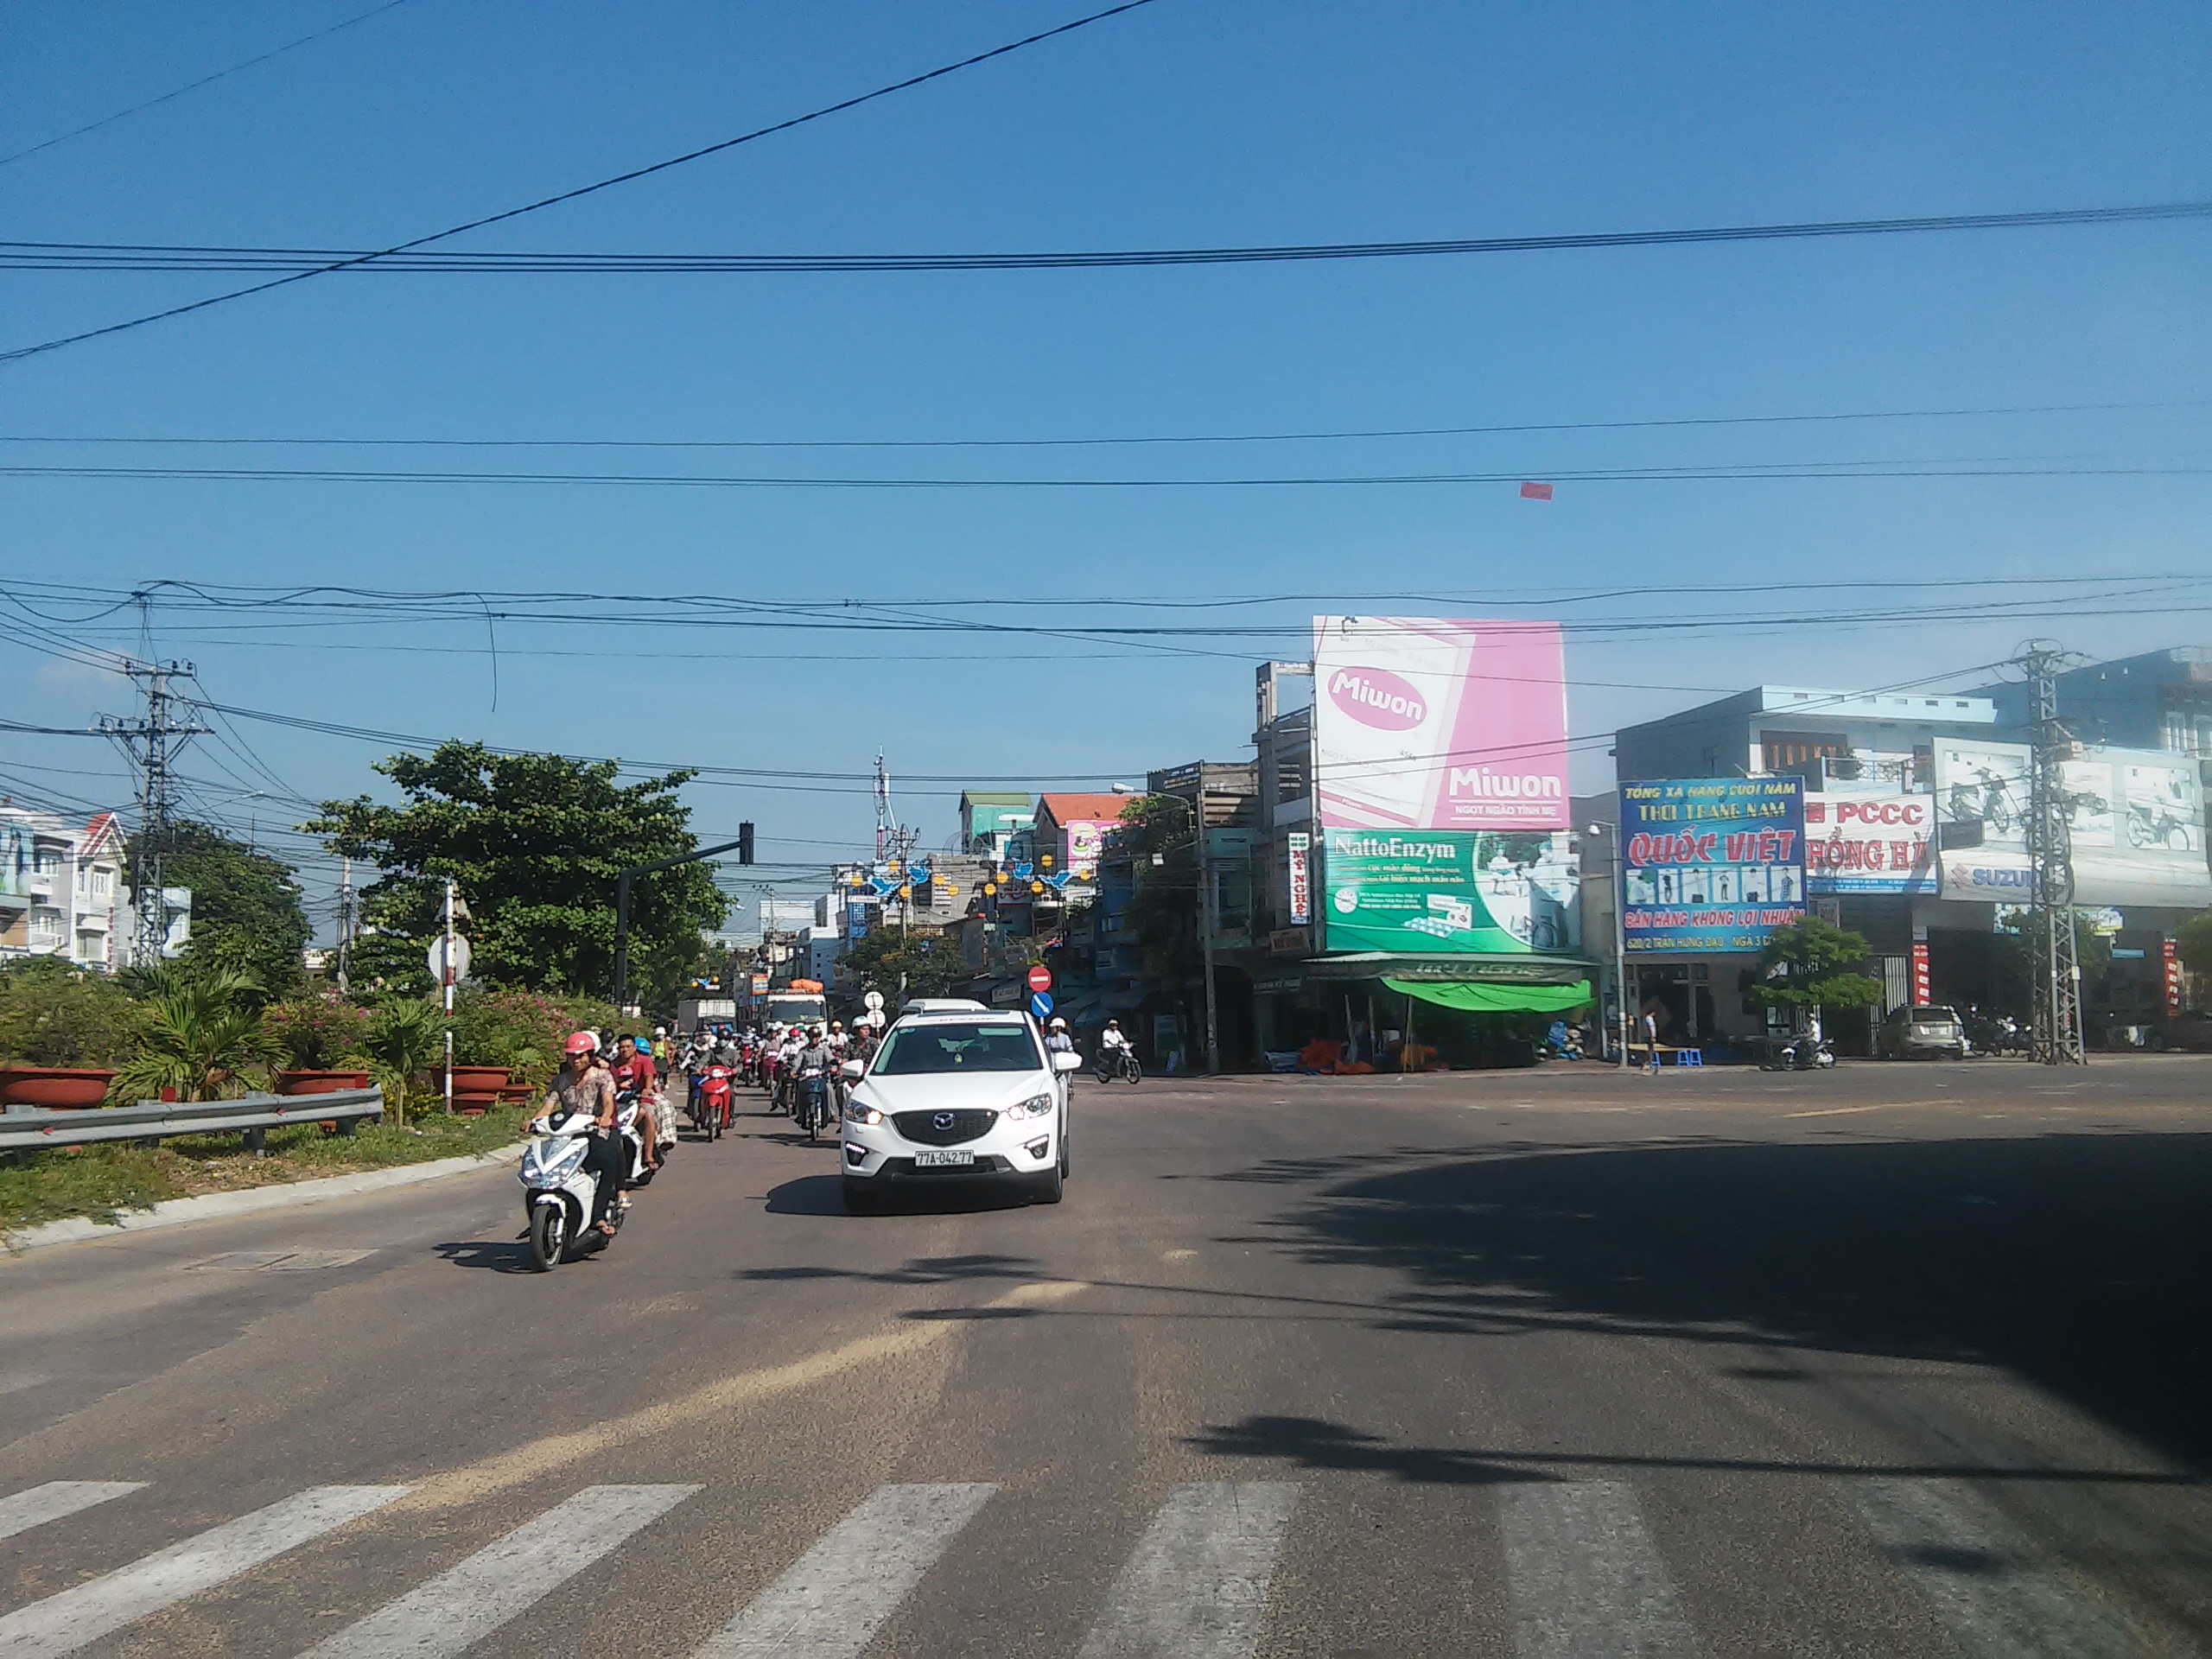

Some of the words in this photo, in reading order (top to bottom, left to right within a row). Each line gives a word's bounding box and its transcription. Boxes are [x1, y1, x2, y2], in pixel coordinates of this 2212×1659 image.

[1332, 671, 1423, 721] Miwon
[1449, 766, 1561, 798] Miwon
[1729, 782, 1762, 796] CUỐI
[1764, 781, 1796, 795] NĂM
[1637, 801, 1677, 822] THỜI
[1684, 803, 1740, 821] TRANG
[1746, 801, 1786, 818] NAM
[1837, 802, 1924, 825] PCCC
[1334, 836, 1456, 863] NattoEnzym
[1629, 824, 1717, 867] QUỐC
[1726, 826, 1796, 868] VIỆT
[1973, 868, 2033, 887] SUZU
[1625, 908, 1652, 928] BÁN
[1653, 907, 1688, 928] HÀNG
[1690, 907, 1734, 927] KHÔNG
[1737, 910, 1759, 931] LỢI
